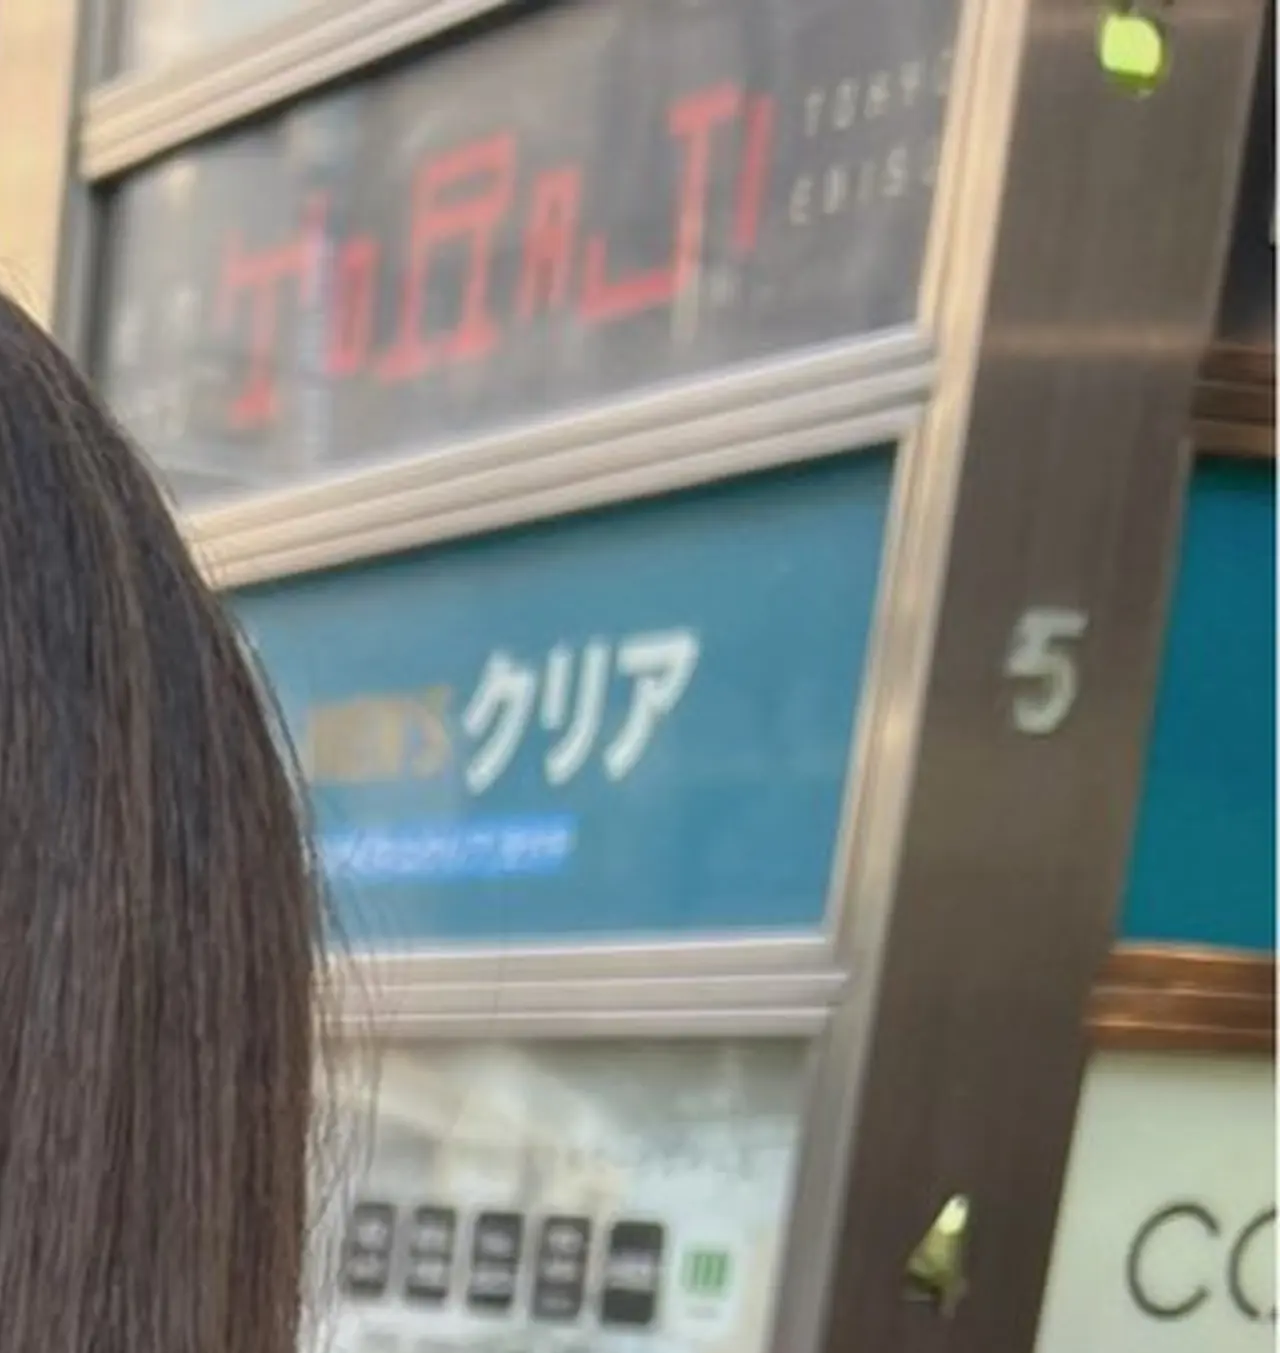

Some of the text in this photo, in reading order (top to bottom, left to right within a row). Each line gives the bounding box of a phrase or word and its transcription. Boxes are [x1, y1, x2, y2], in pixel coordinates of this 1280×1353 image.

[462, 626, 700, 795] クリア
[1007, 608, 1090, 736] 5
